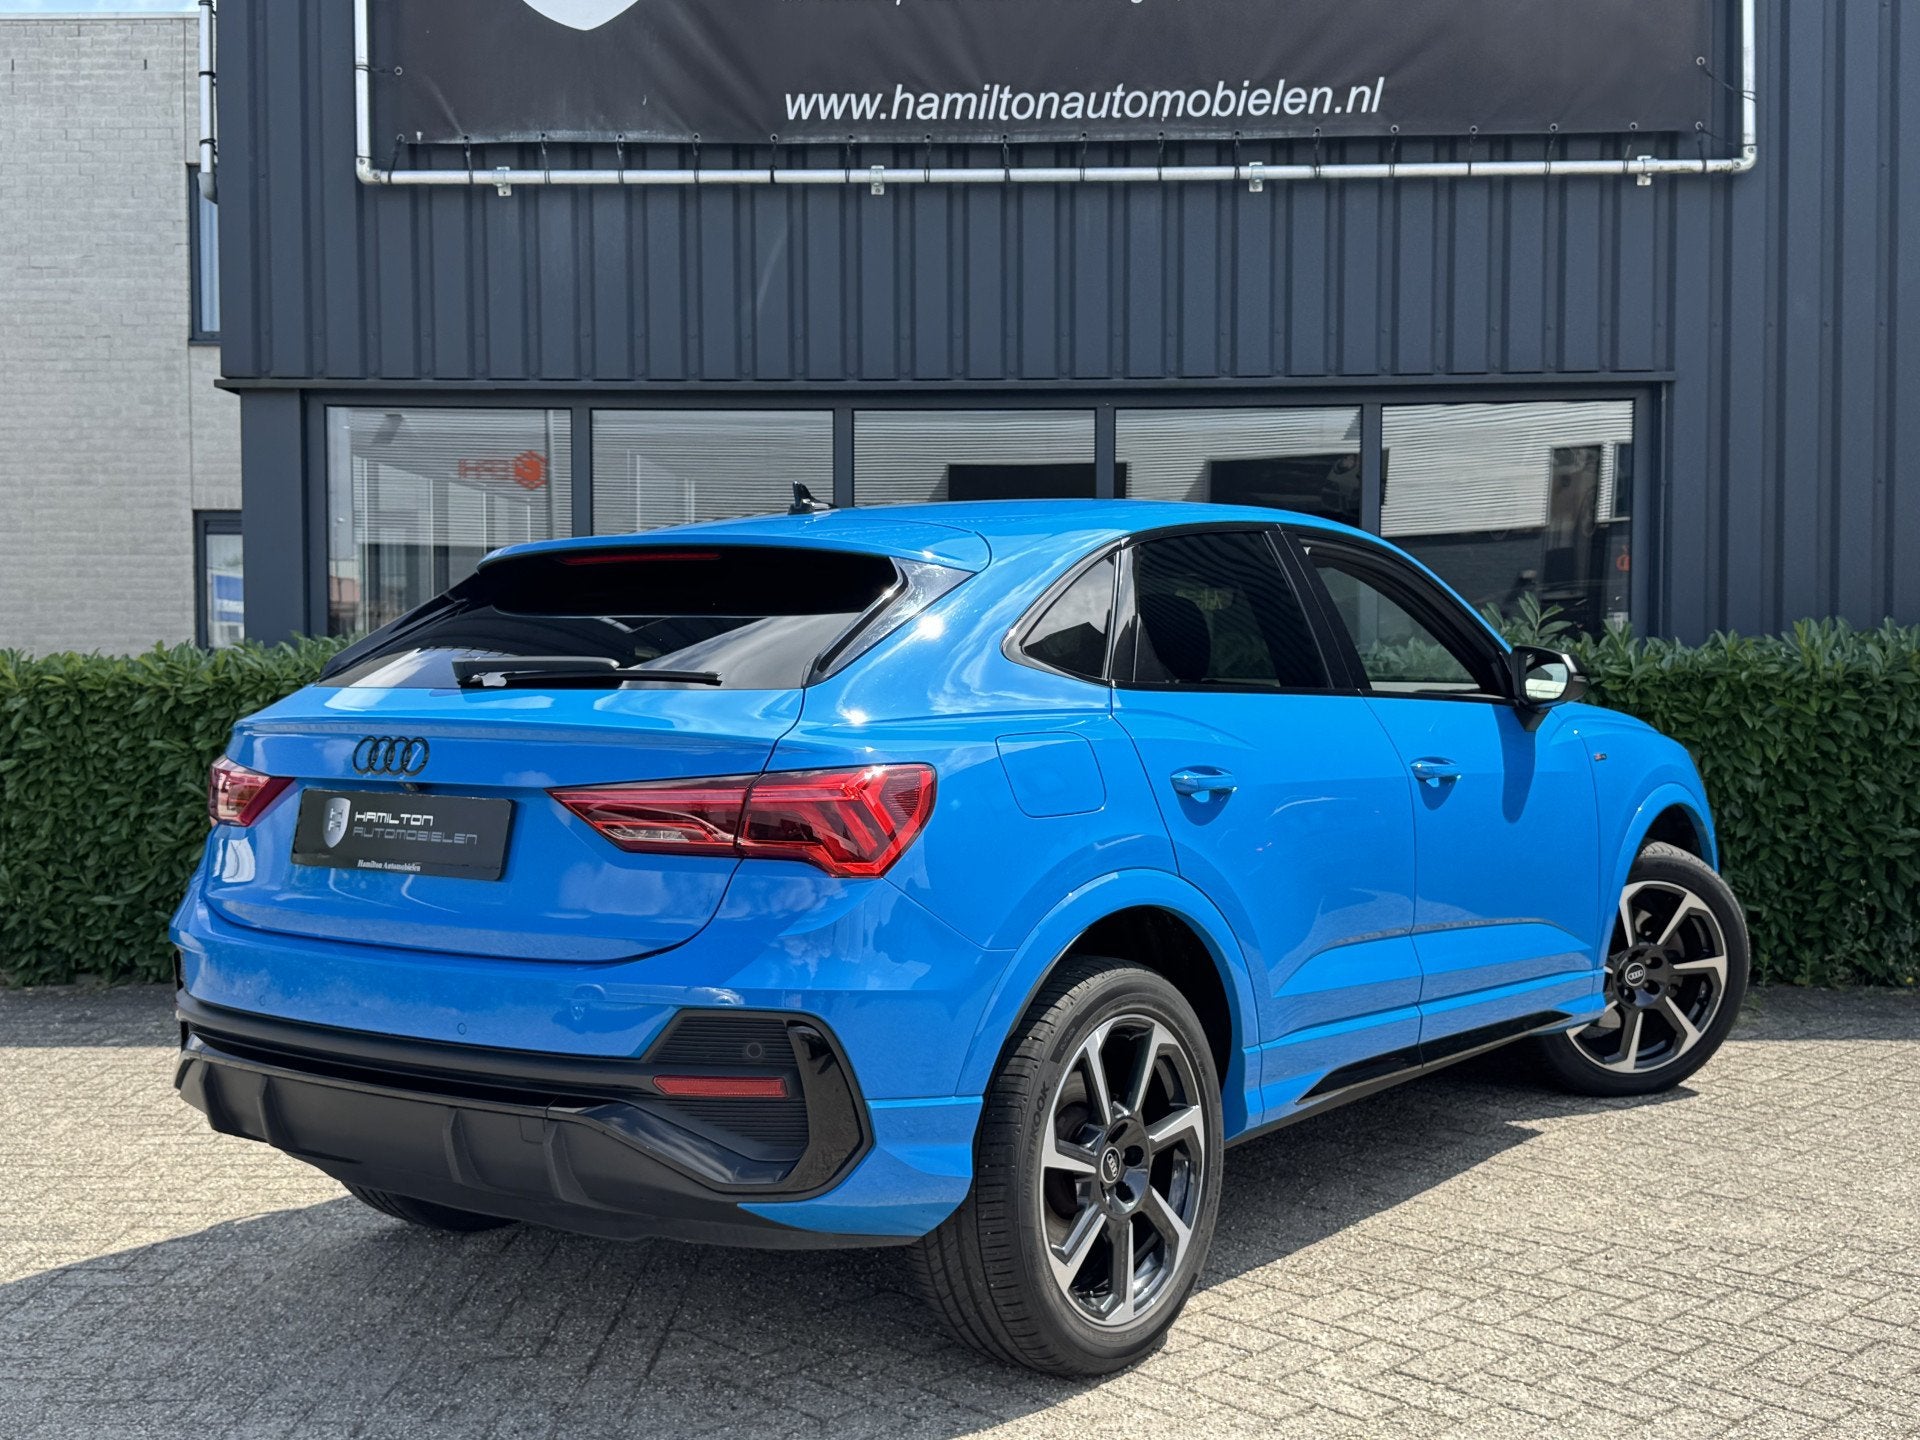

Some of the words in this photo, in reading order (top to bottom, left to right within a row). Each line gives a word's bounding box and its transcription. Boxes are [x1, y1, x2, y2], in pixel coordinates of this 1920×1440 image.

[785, 76, 1385, 121] www.hamiltonautomobielen.nl
[354, 811, 434, 827] HAMILTON
[352, 826, 478, 845] AUTOMOBIELEN
